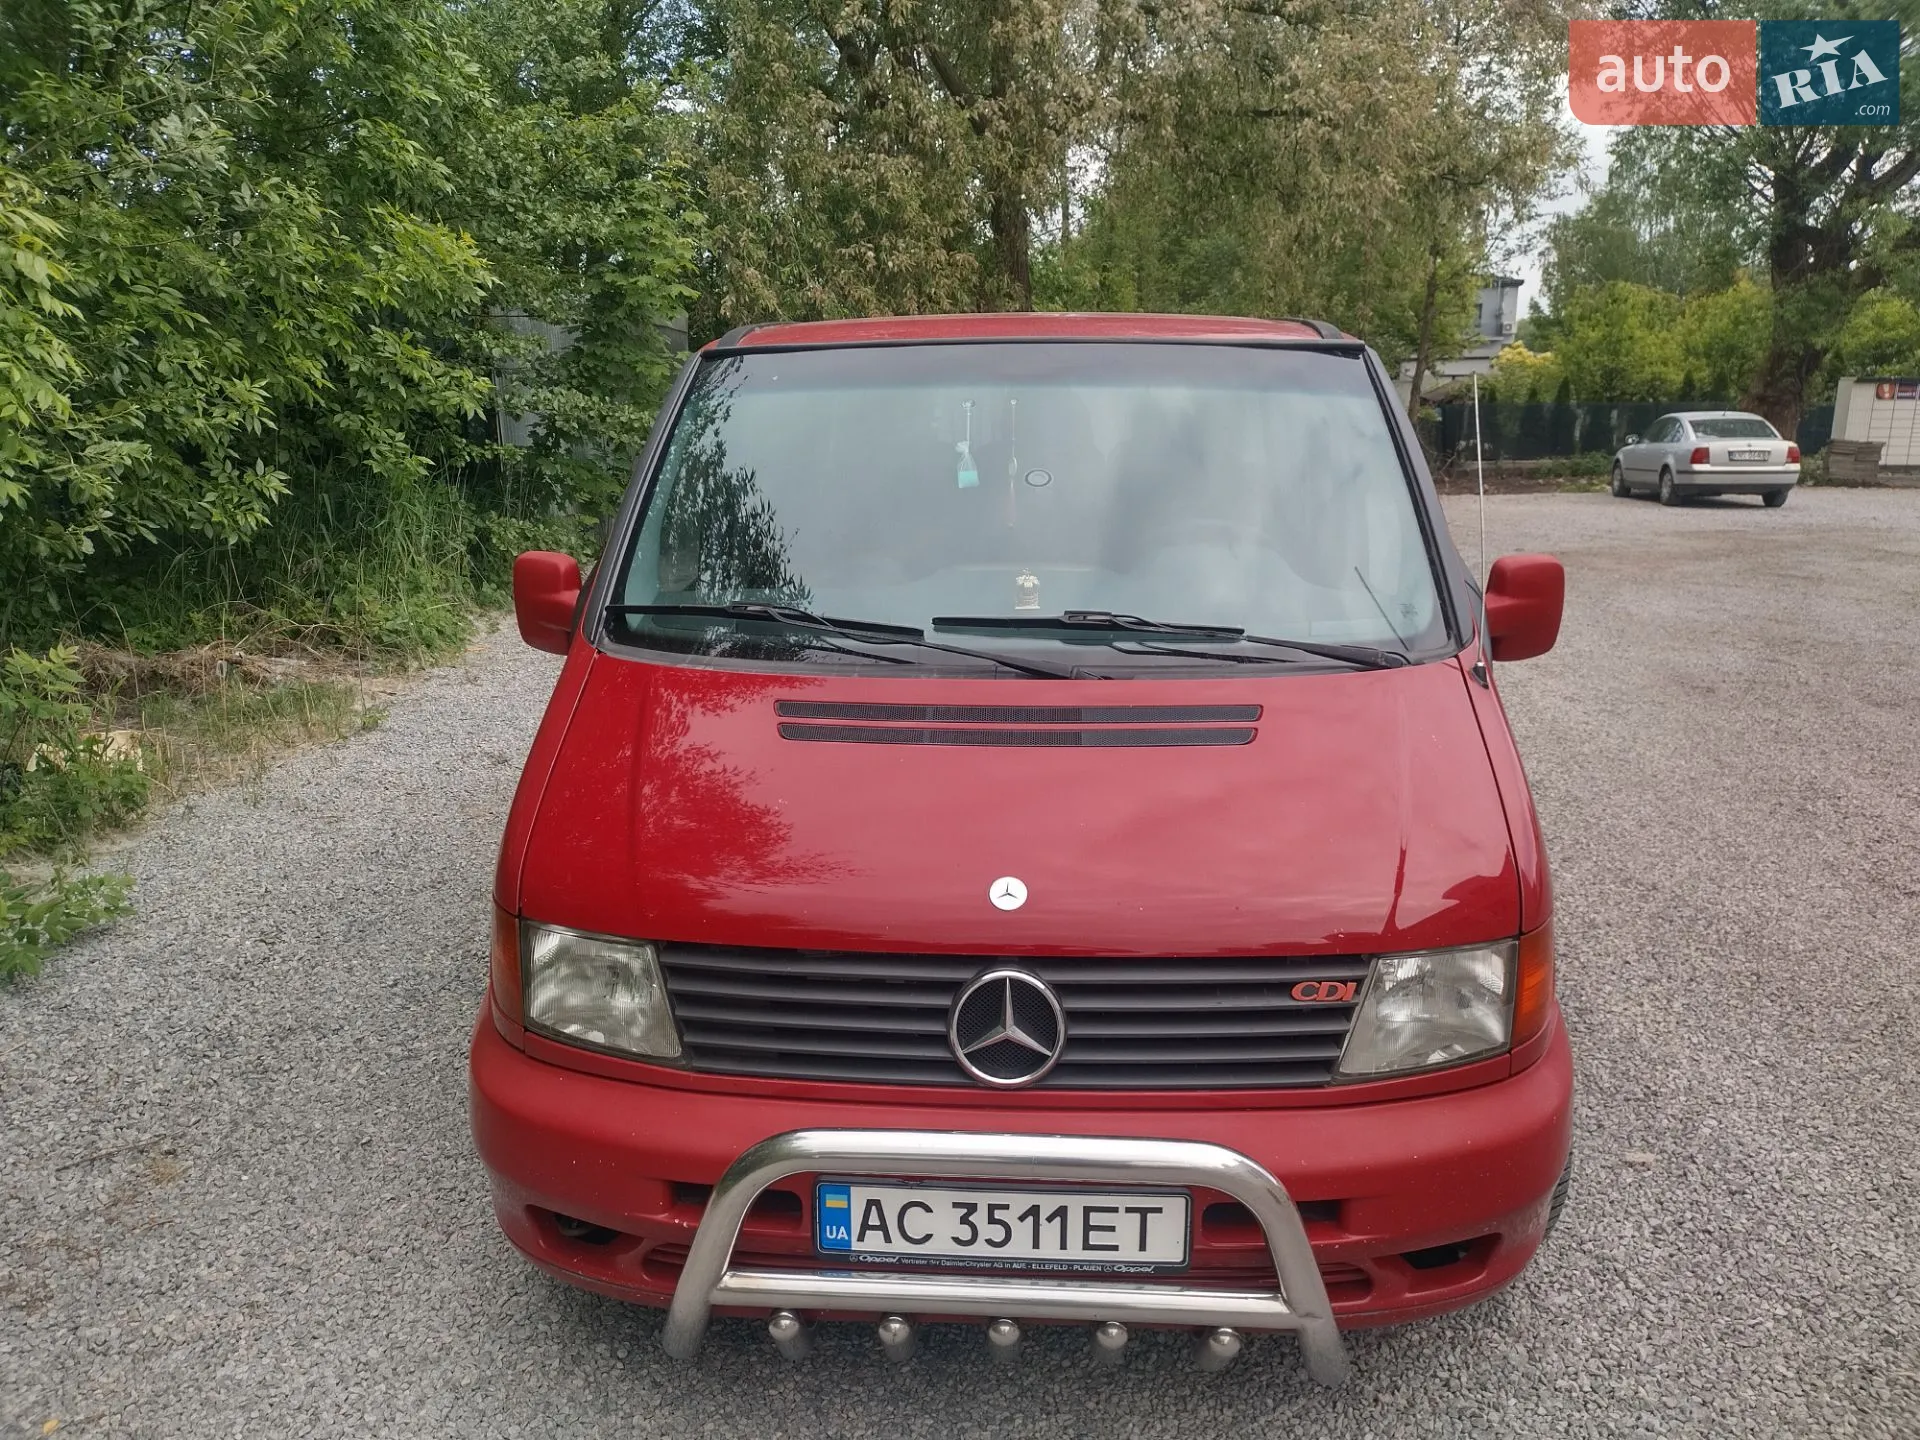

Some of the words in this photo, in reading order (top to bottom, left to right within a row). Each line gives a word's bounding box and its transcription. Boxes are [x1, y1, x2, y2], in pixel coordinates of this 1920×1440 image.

[1290, 980, 1358, 1002] CDI
[826, 1225, 849, 1241] UA
[856, 1198, 934, 1245] AC
[950, 1201, 1069, 1250] 3511
[1082, 1206, 1164, 1253] ET
[941, 1259, 992, 1269] DaimlerChrysler
[1032, 1263, 1068, 1271] ELLEFELD
[1073, 1264, 1102, 1272] PLAUEN
